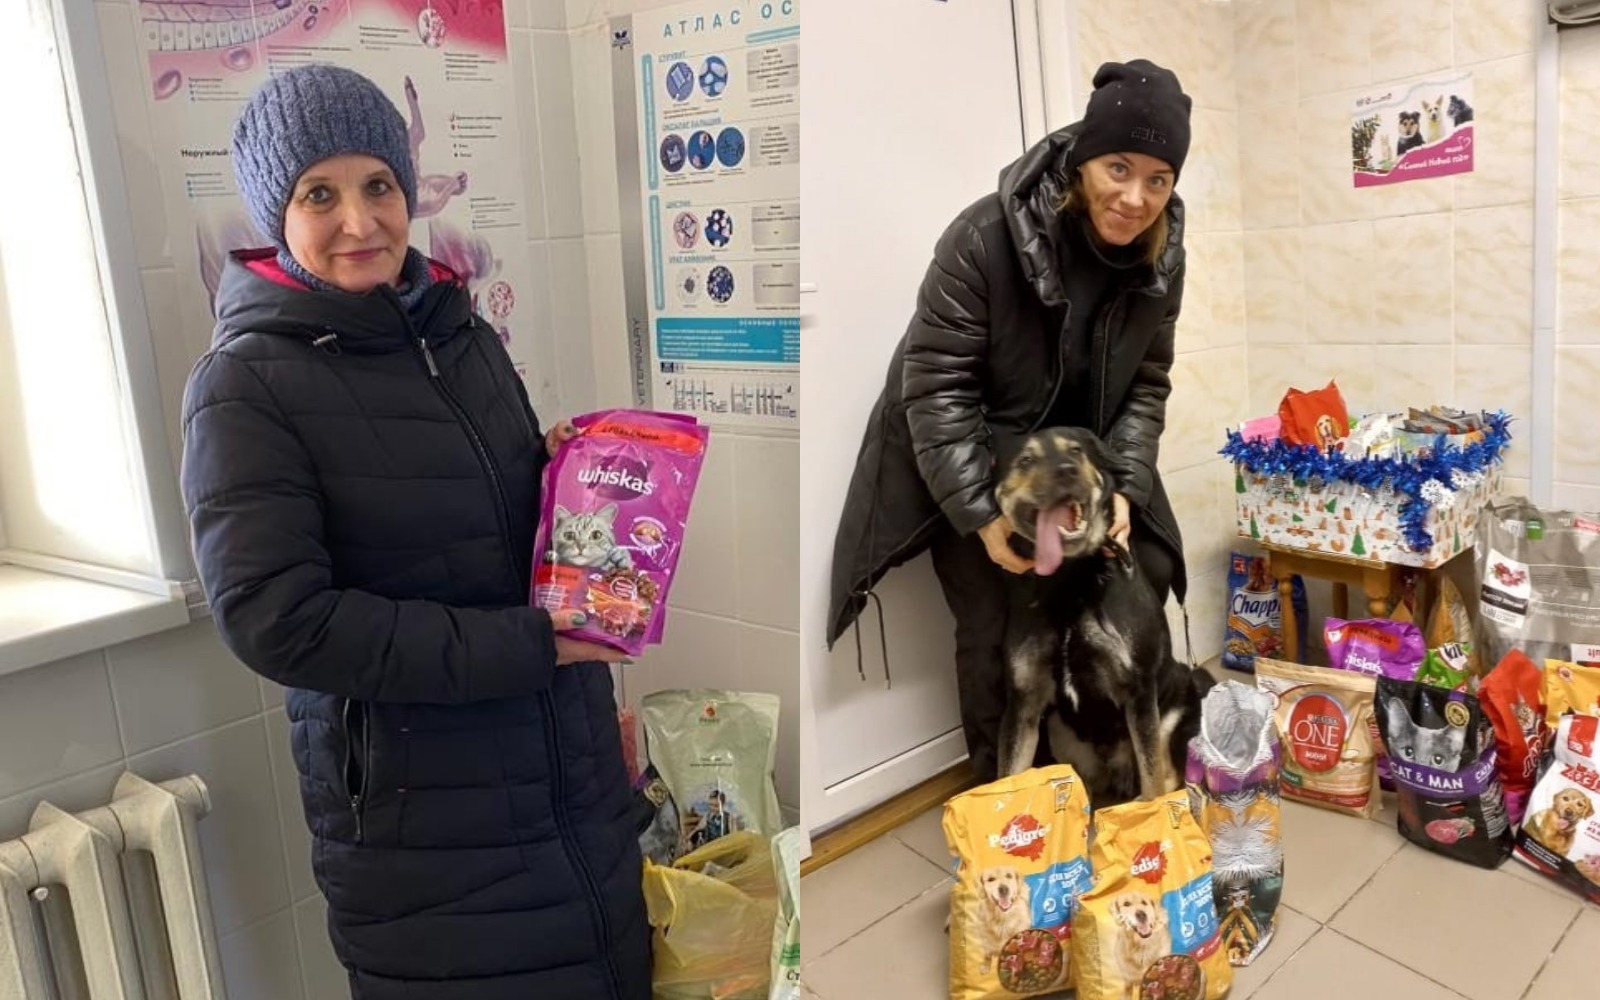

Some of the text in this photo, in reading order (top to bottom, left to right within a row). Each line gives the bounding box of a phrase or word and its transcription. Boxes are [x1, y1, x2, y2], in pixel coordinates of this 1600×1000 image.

[663, 9, 741, 38] АТЛАС
[577, 465, 653, 495] whiskas
[1294, 720, 1340, 748] ONE
[1390, 762, 1463, 790] CAT & MAN
